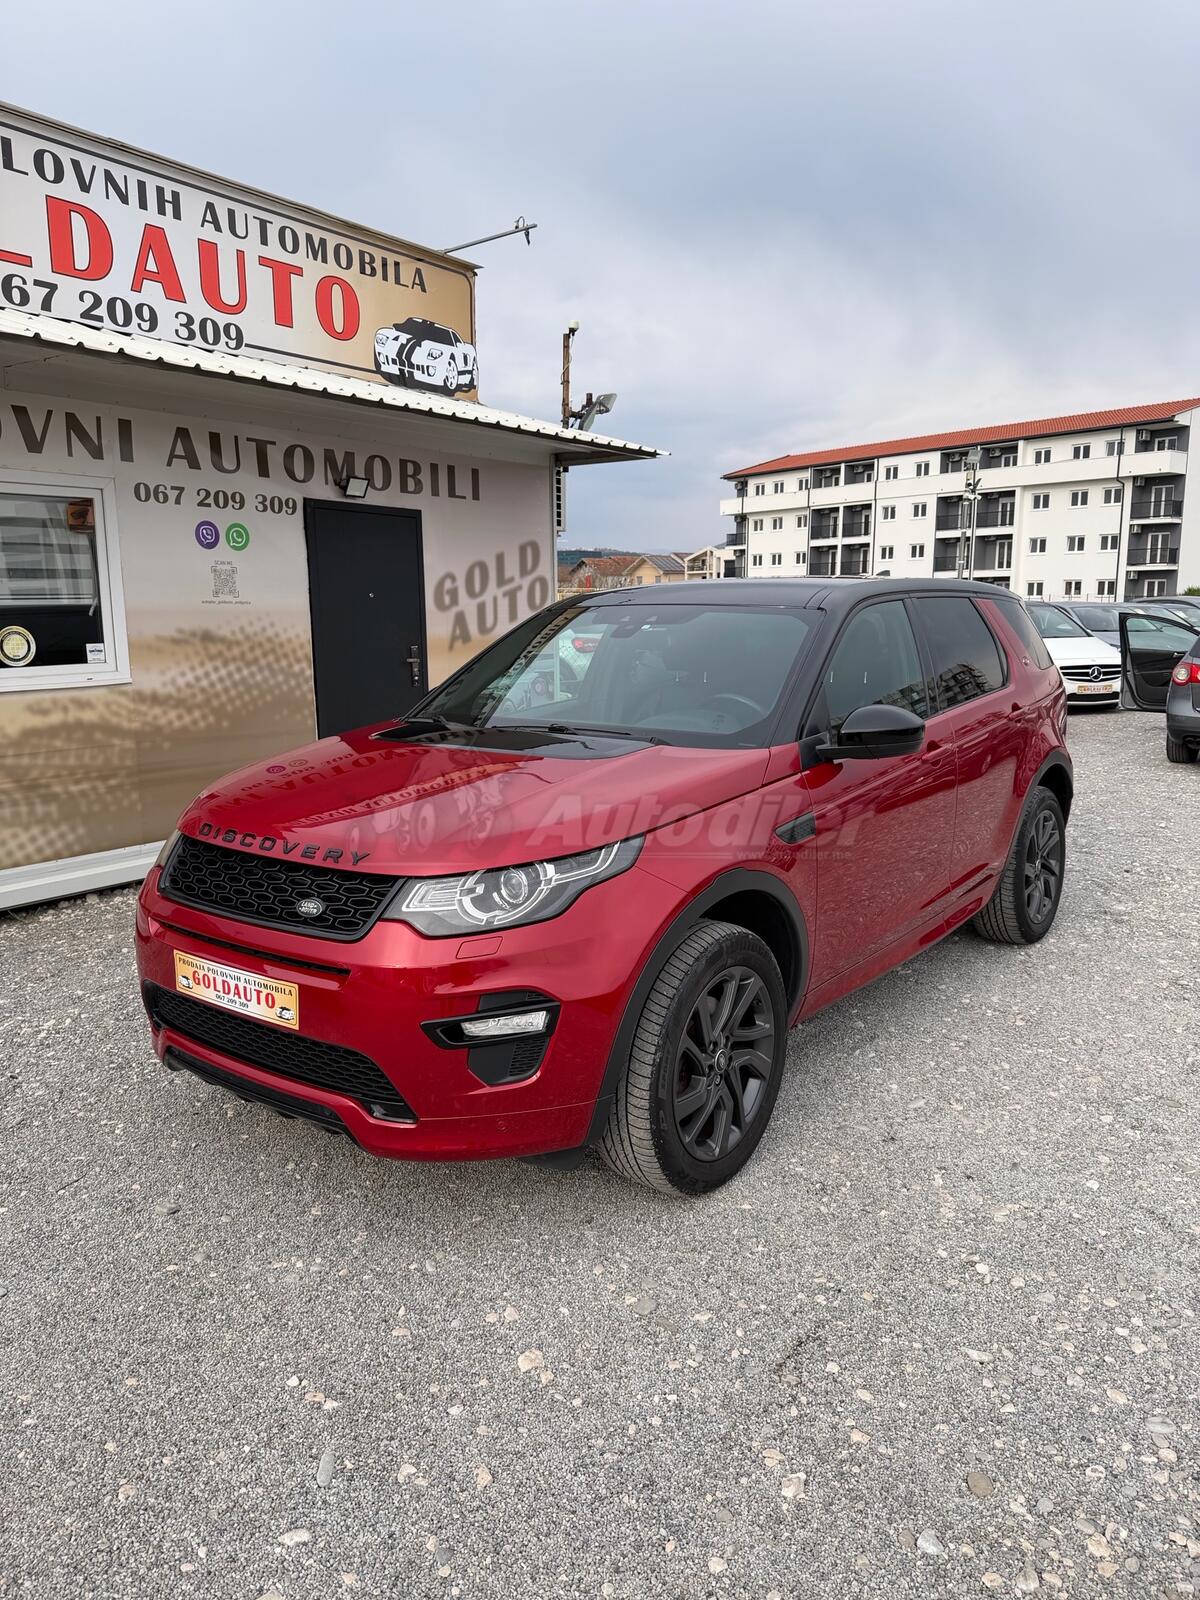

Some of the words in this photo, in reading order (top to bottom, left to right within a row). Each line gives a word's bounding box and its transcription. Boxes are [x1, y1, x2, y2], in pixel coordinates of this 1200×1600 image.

[200, 201, 428, 293] AUTOMOBILA
[78, 290, 158, 334] 209
[174, 311, 244, 351] 309
[0, 404, 134, 463] VNI
[166, 426, 480, 501] AUTOMOBILI
[133, 482, 185, 505] 067
[196, 488, 245, 511] 209
[255, 493, 297, 515] 309
[433, 540, 541, 612] GOLD
[448, 574, 550, 652] AUTO
[199, 822, 371, 867] DISCOVERY
[178, 957, 205, 972] PRODAJA
[207, 965, 241, 983] POLOVNIH
[243, 977, 293, 997] AUTOMOBILA
[192, 970, 276, 1009] GOLDAUTO
[215, 993, 225, 1002] 067
[226, 996, 237, 1006] 209
